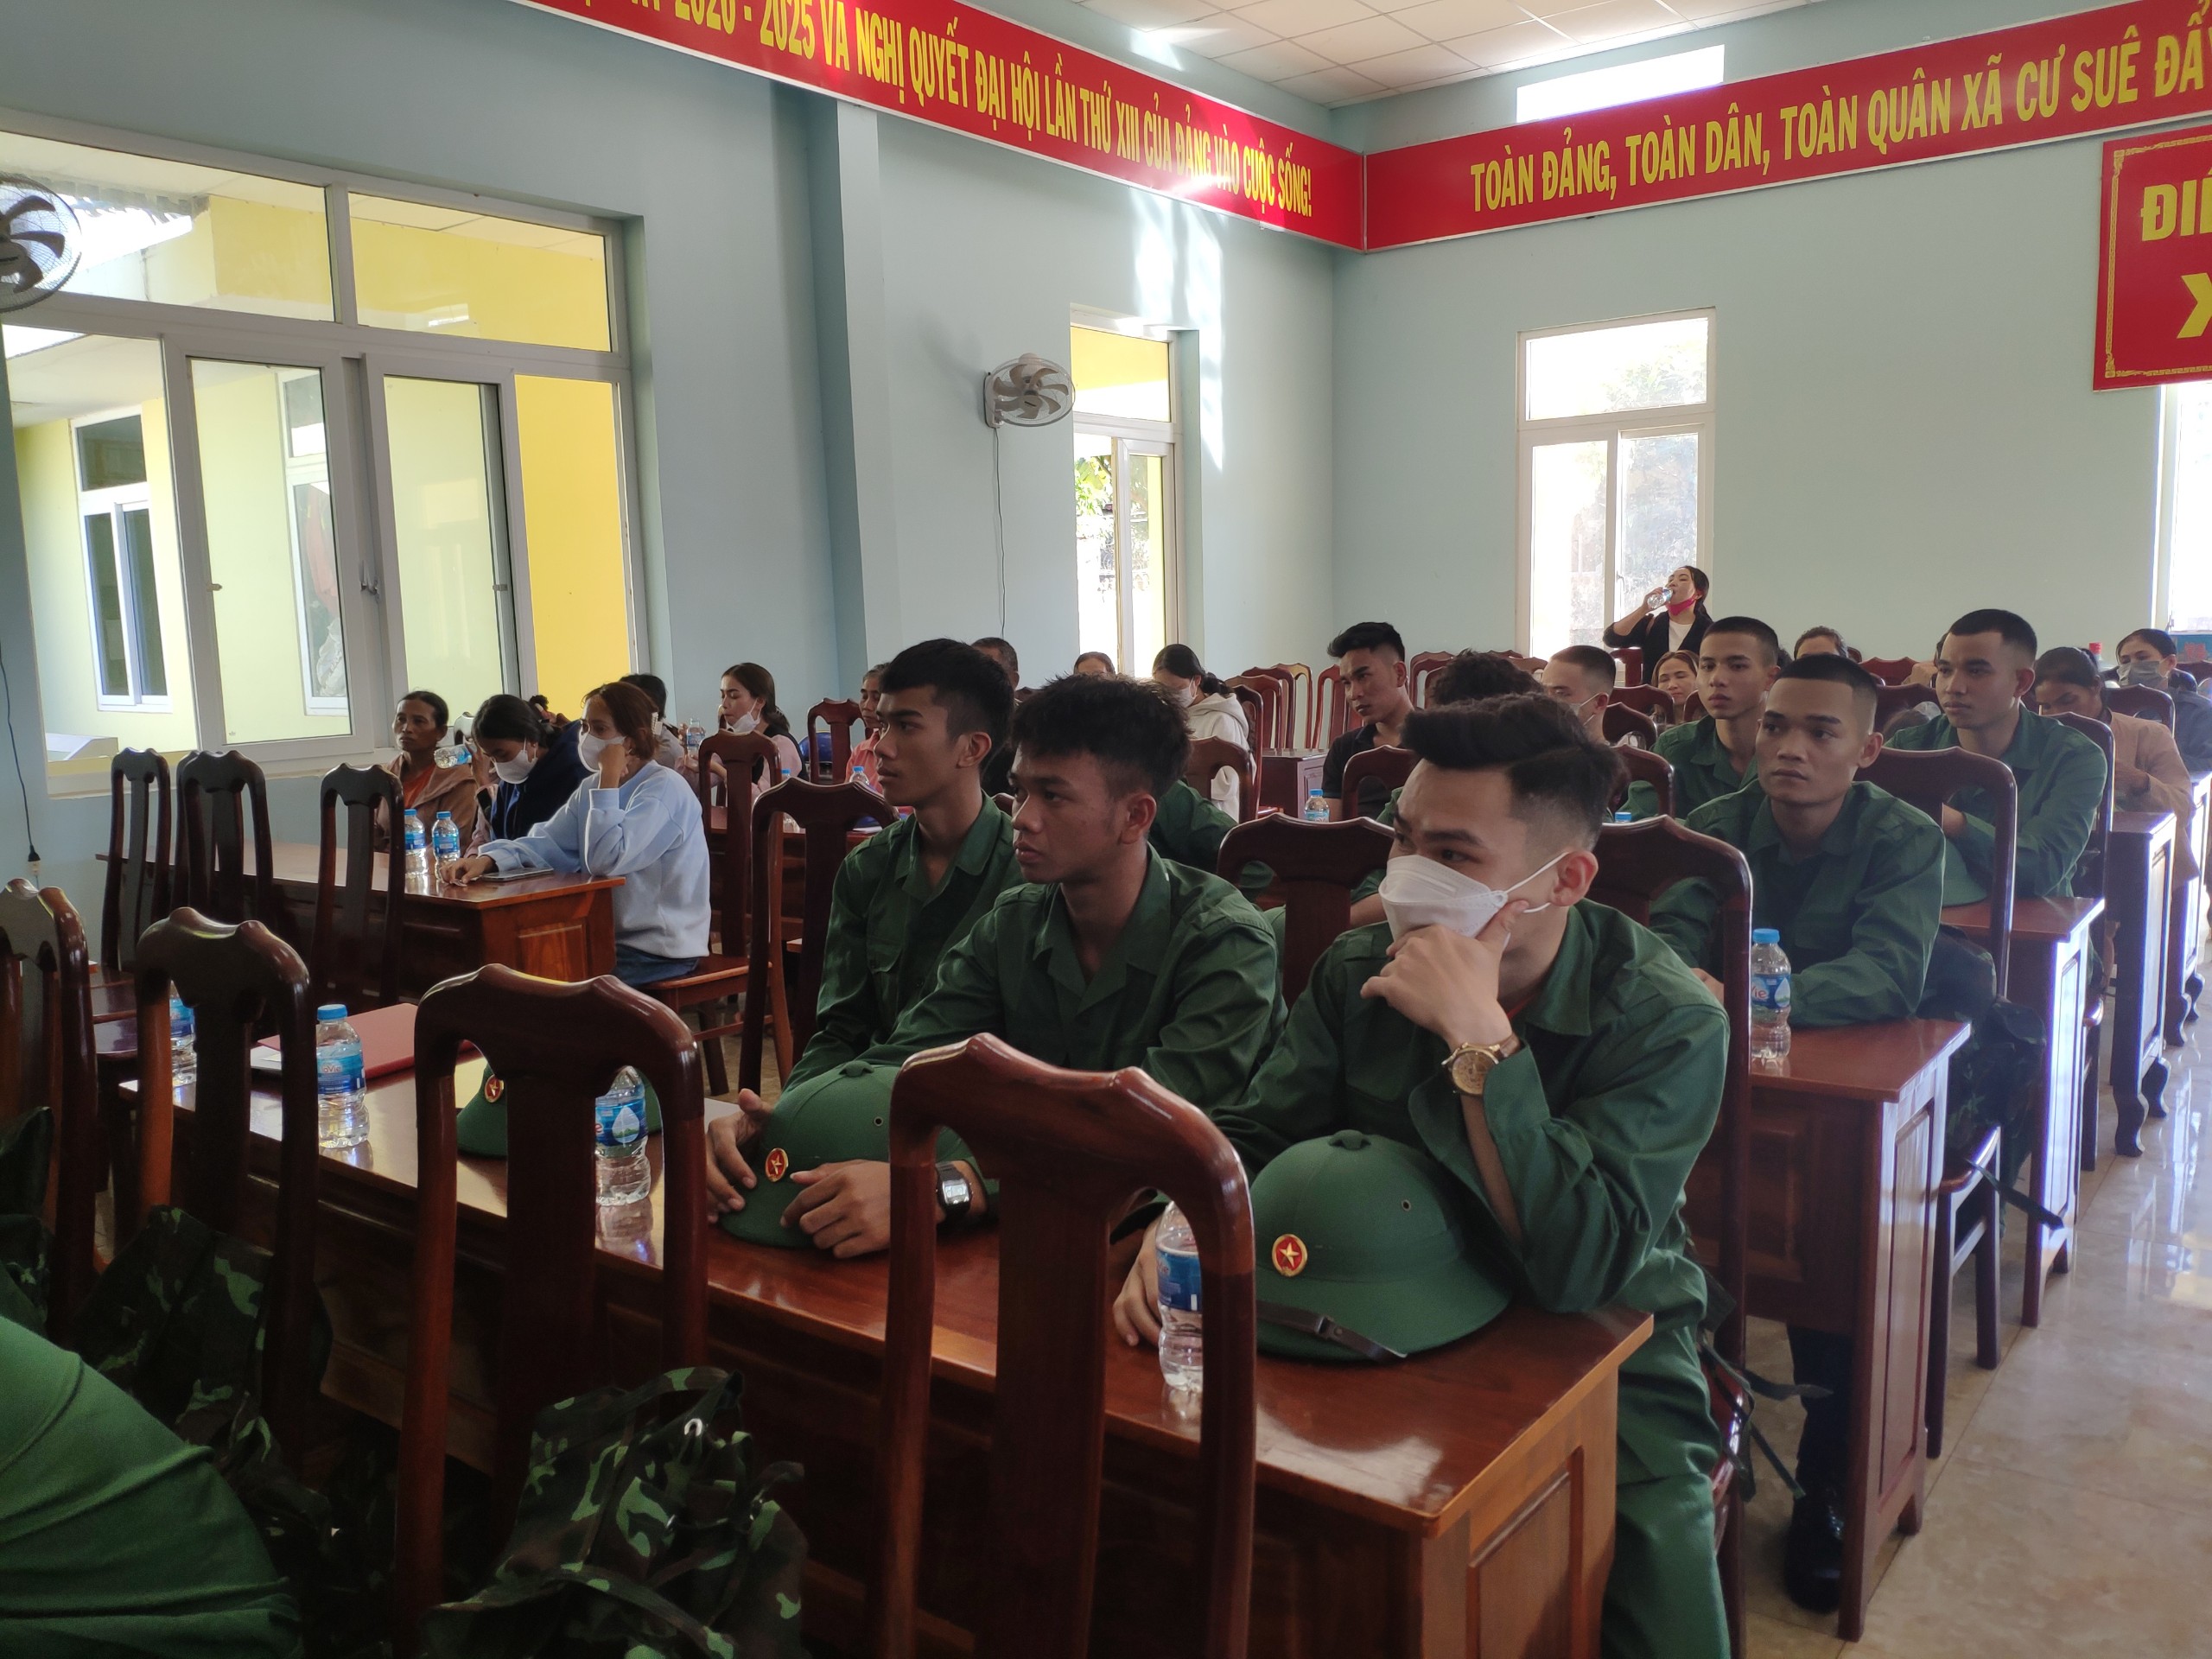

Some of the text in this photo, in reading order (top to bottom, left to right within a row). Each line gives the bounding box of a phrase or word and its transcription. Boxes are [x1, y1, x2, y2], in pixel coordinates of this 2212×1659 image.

[760, 0, 816, 60] 2025
[855, 7, 905, 105] NGHỊ
[909, 17, 969, 108] QUYẾT
[975, 49, 1007, 130] ĐẠI
[1010, 51, 1041, 142] HỘI
[1045, 53, 1077, 143] LẦN
[1080, 80, 1112, 154] THỨ
[1116, 100, 1141, 162] XIII
[1144, 92, 1173, 173] CỦA
[1175, 104, 1212, 188] ĐẢNG
[1214, 124, 1240, 195] VÀO
[1243, 137, 1275, 214] CUỘC
[1278, 142, 1313, 217] SỐNG!
[1471, 0, 2212, 212] TOÀN ĐẢNG, TOÀN DÂN, TOÀN QUÂN XÃ CƯ SUÊ ĐẨ
